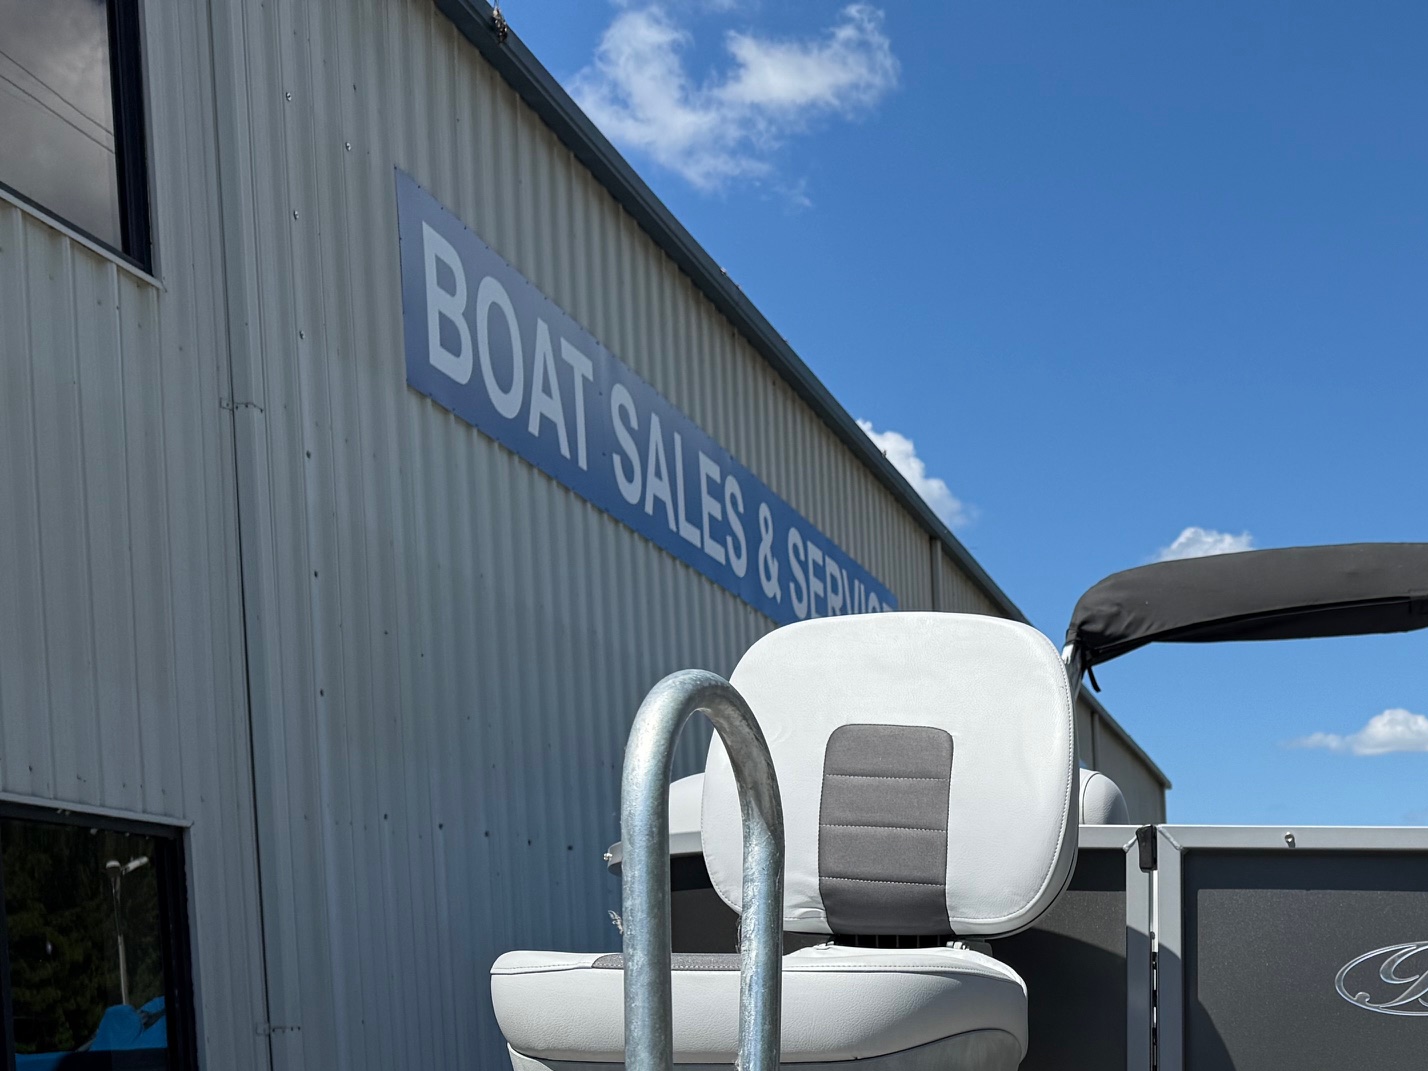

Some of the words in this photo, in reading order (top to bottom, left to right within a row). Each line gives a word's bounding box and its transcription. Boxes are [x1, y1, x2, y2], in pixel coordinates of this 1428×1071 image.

[421, 219, 594, 473] BOAT
[609, 382, 749, 579] SALES
[757, 501, 782, 605] &
[787, 527, 894, 620] SERV
